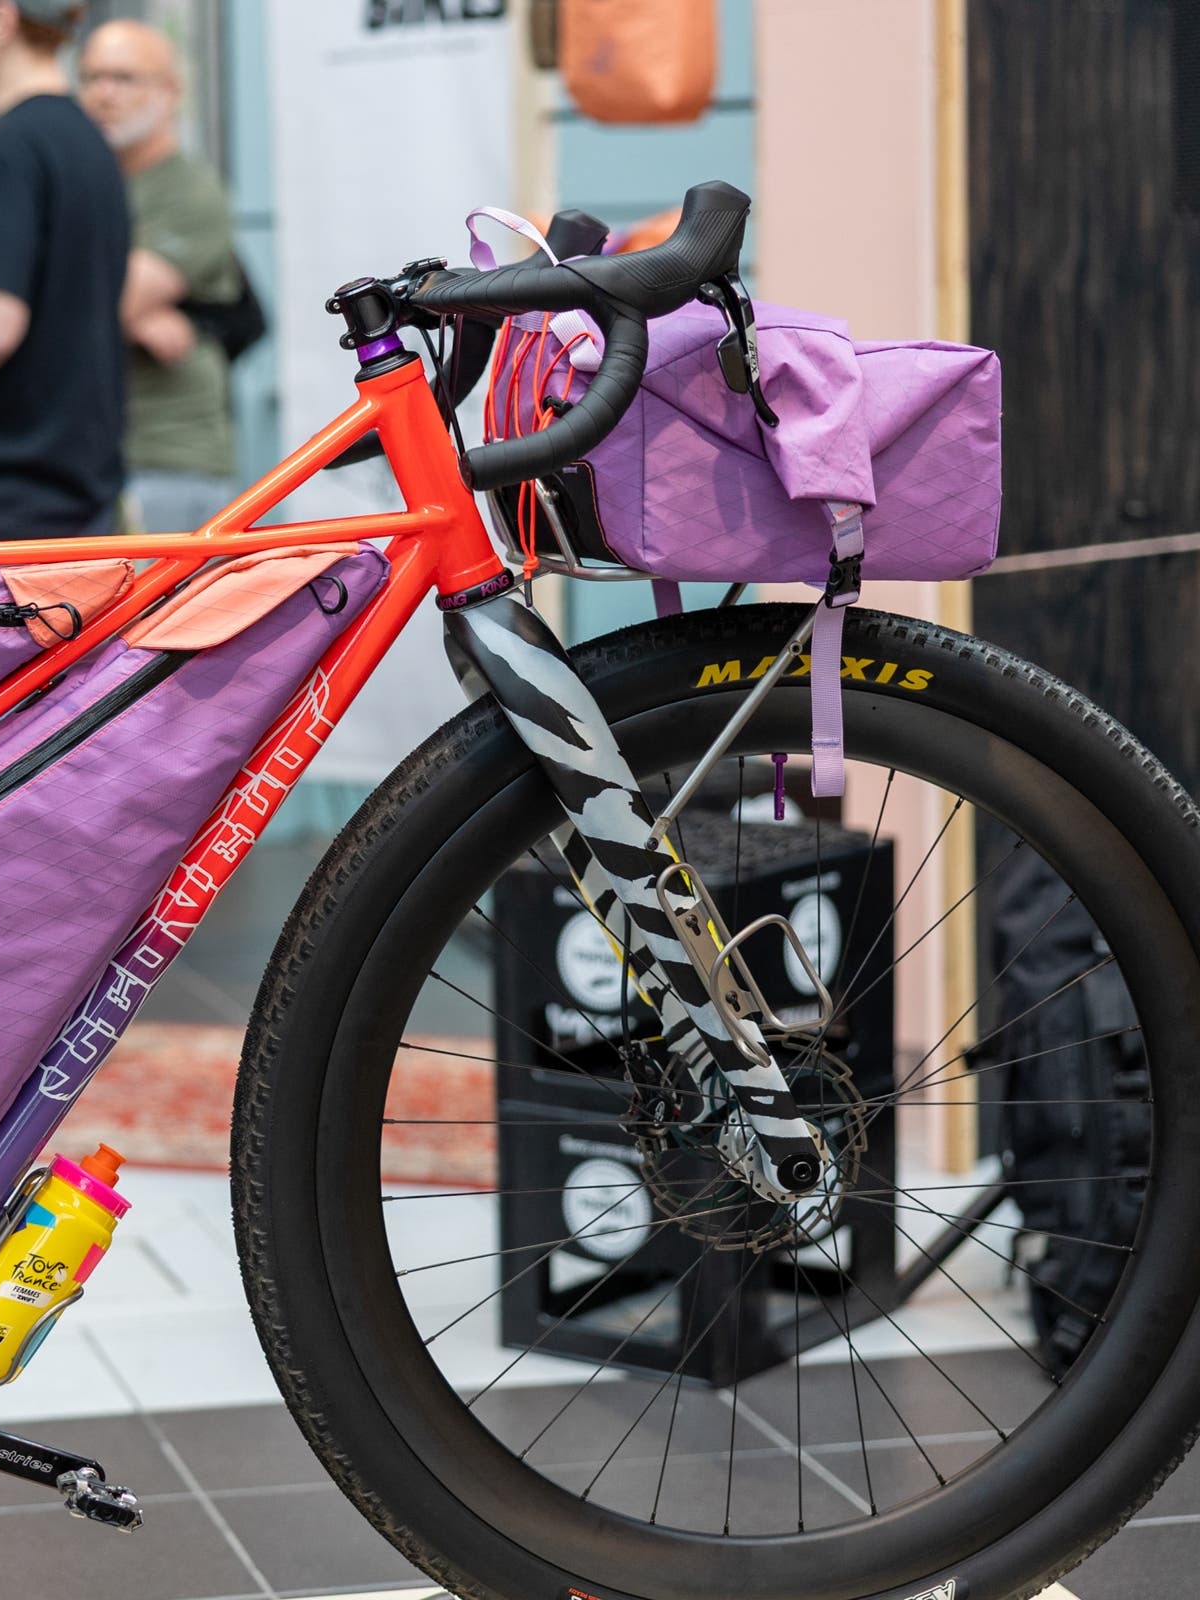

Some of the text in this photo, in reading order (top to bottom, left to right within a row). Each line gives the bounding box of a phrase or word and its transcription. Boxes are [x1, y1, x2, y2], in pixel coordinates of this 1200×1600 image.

[480, 574, 510, 598] KING
[440, 593, 467, 609] KING
[12, 1285, 41, 1298] FEMMES
